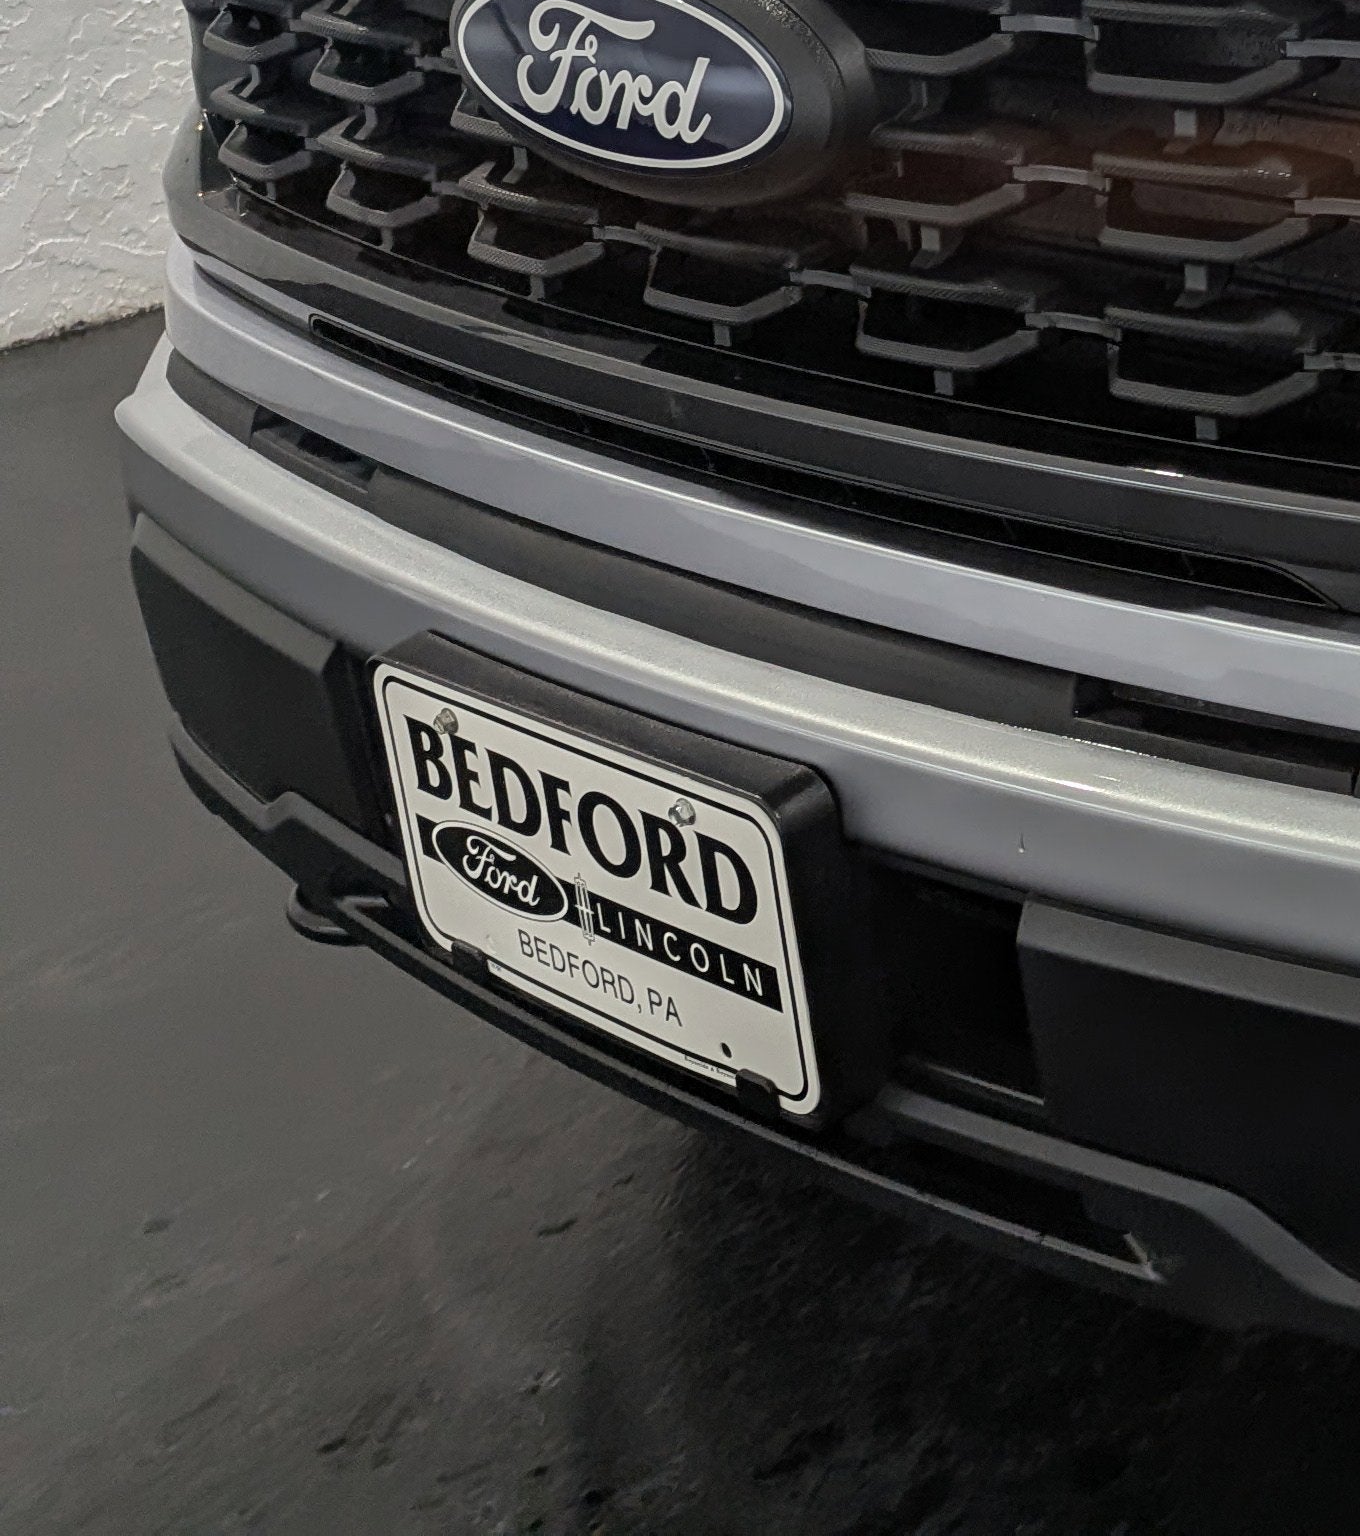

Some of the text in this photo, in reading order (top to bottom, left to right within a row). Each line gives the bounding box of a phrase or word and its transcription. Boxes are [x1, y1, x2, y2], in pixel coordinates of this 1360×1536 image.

[402, 714, 758, 925] BEDFORD
[462, 835, 763, 997] Ford LINCOLN
[517, 928, 684, 1027] BEDFORD, PA
